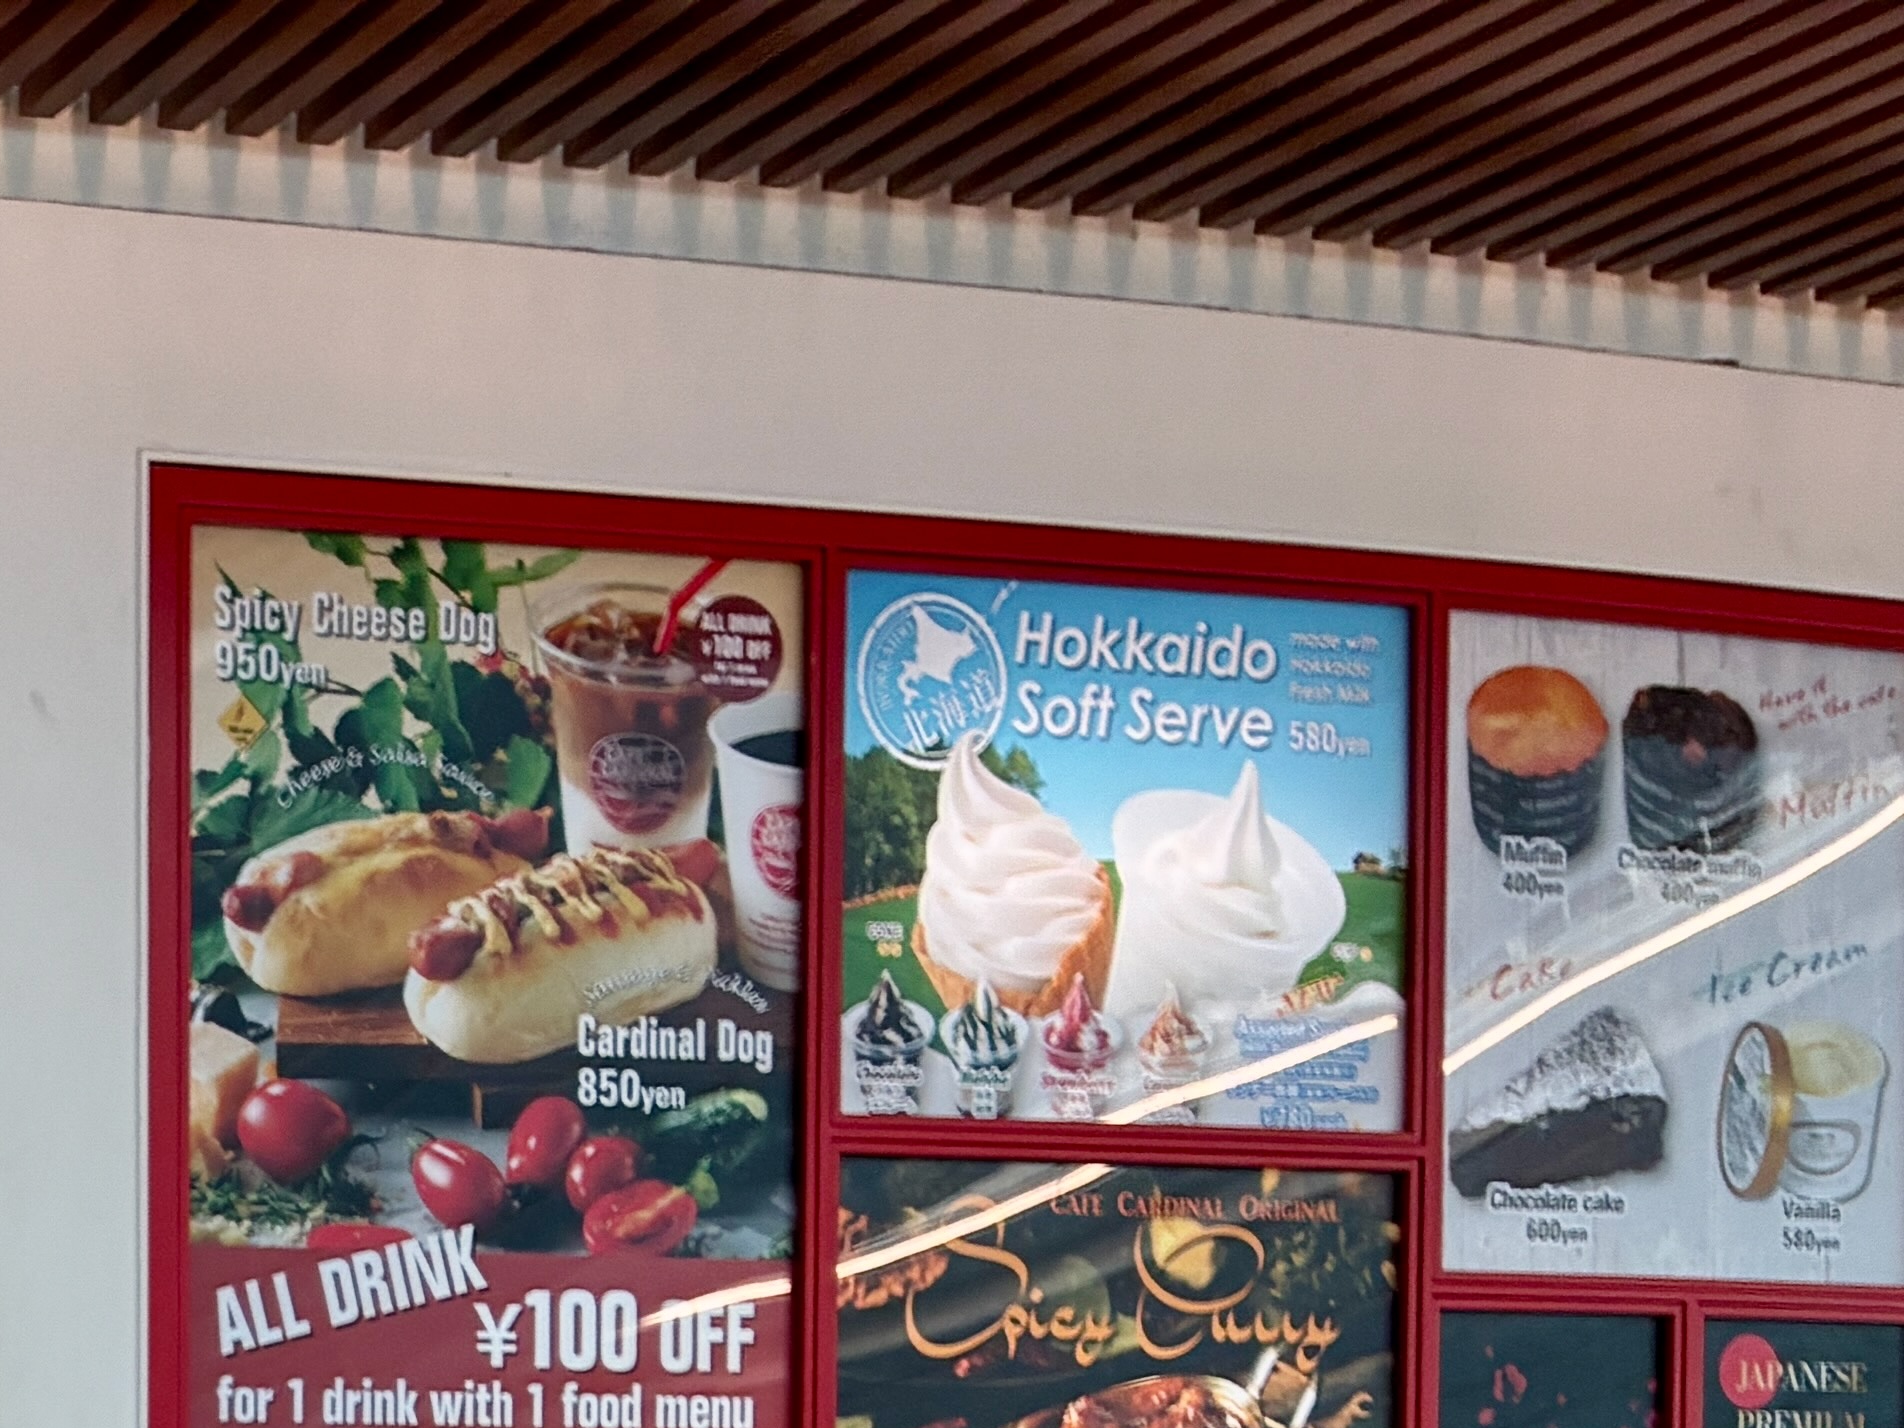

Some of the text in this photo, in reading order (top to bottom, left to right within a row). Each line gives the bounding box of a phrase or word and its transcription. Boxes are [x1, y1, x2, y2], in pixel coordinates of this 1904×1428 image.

[214, 584, 498, 651] Spicy Cheese Dog
[215, 644, 330, 689] 950yen
[1014, 609, 1277, 682] Hokkaido
[1012, 681, 1116, 739] Soft
[1124, 688, 1273, 750] Serve
[578, 1015, 774, 1072] Cardinal Dog
[577, 1068, 685, 1111] 850yen
[1491, 1190, 1625, 1216] Chocolate cake
[1782, 1200, 1841, 1224] Vanilla
[216, 1225, 755, 1374] ALL DRINK ¥100 OFF
[216, 1375, 273, 1424] for
[286, 1378, 303, 1424] 1
[323, 1377, 418, 1426] drink
[431, 1381, 513, 1428] with
[528, 1382, 544, 1428] 1
[1735, 1361, 1867, 1393] JAPANESE
